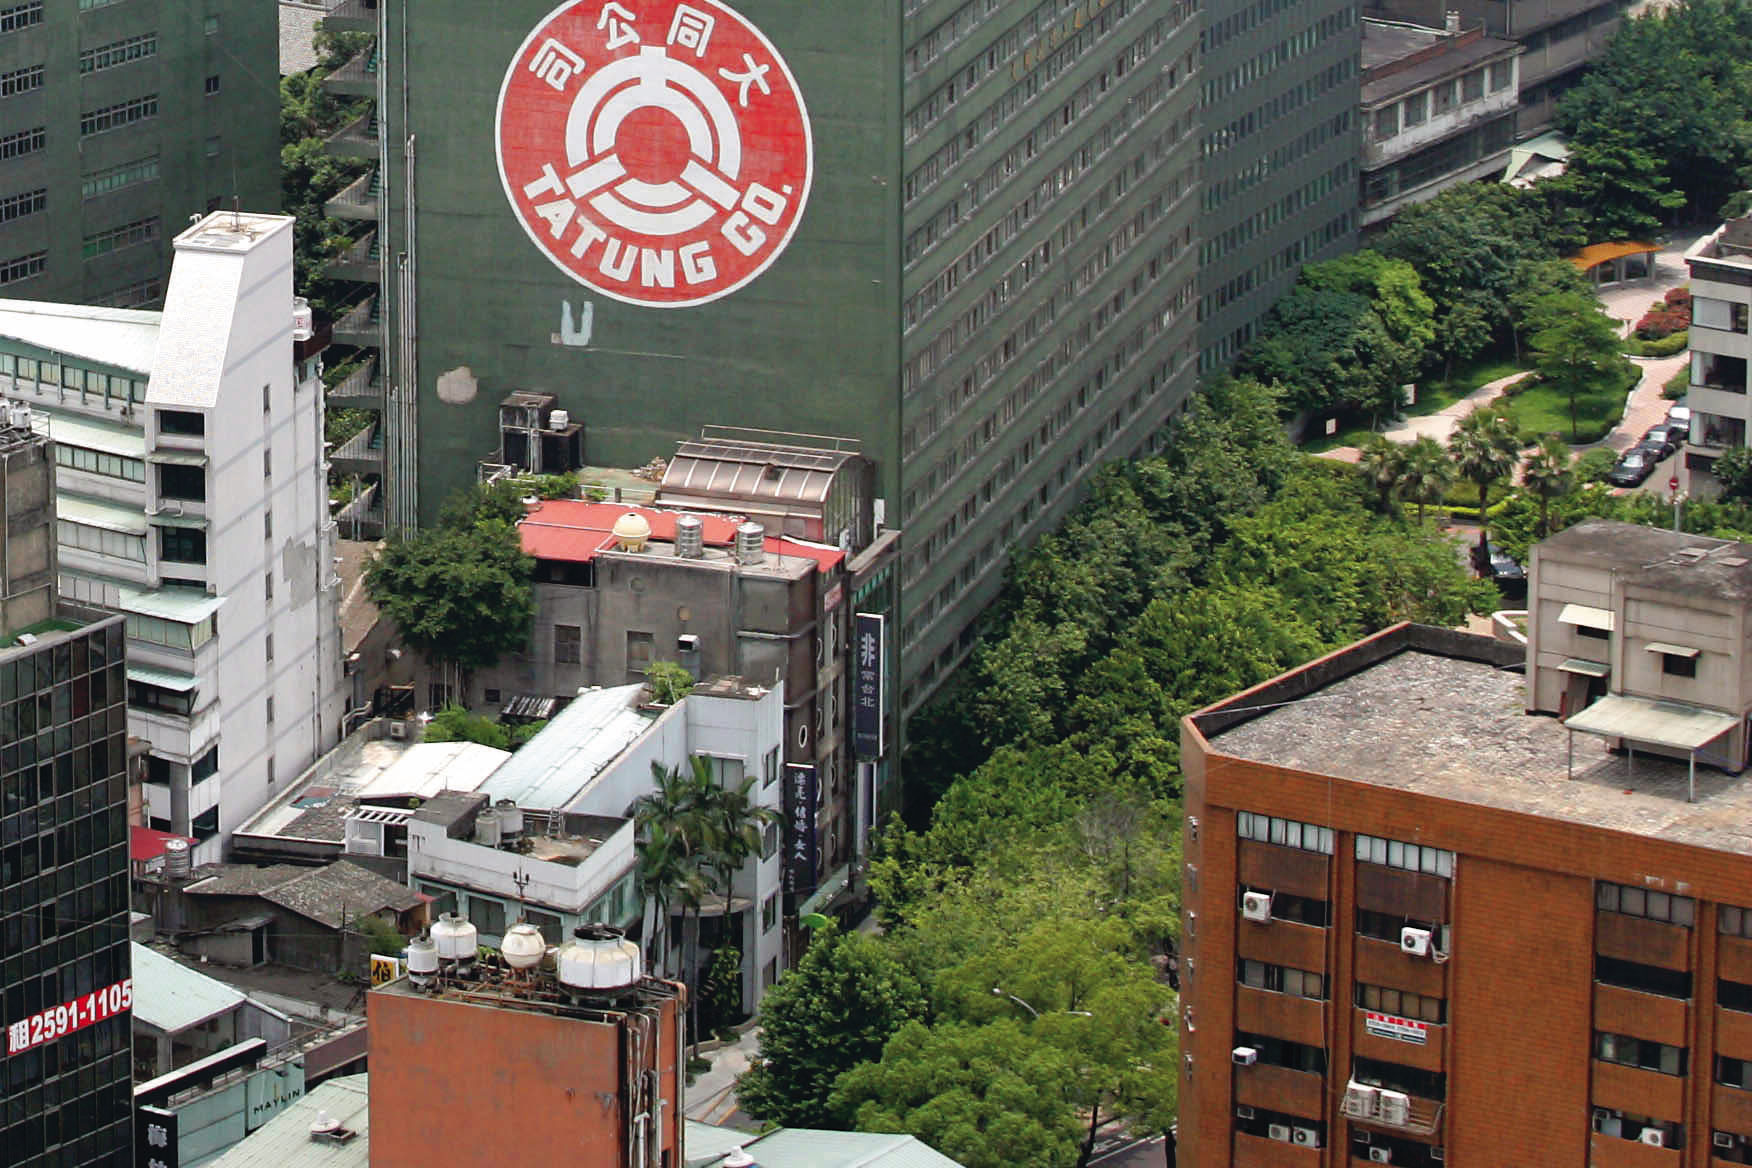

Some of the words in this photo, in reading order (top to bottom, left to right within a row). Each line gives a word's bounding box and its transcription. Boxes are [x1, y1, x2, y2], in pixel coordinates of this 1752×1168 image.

[523, 162, 718, 288] TATUNG
[719, 182, 794, 257] CO.
[254, 1089, 301, 1115] MAYLIN
